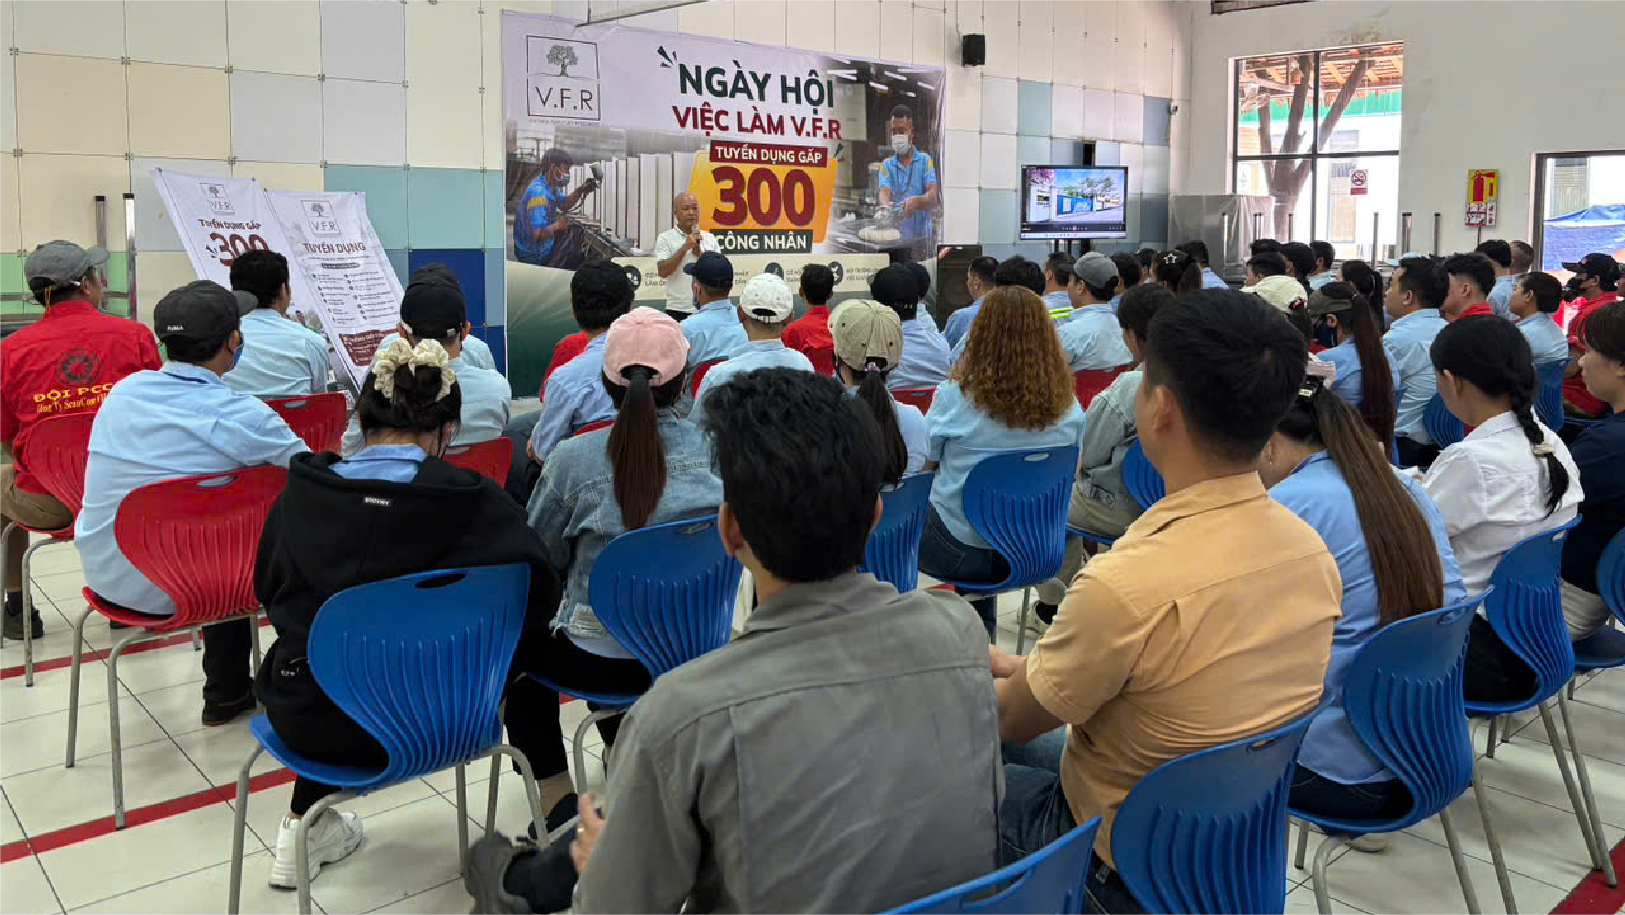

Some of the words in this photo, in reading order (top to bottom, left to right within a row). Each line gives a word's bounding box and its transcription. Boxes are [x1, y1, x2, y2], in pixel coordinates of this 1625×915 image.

[535, 87, 593, 111] V.F.R
[679, 60, 772, 102] NGÀY
[780, 69, 834, 115] HỘI
[672, 102, 729, 136] VIỆC
[737, 106, 784, 136] LÀM
[790, 116, 842, 140] V.F.R
[715, 144, 757, 160] TUYỂN
[761, 149, 795, 164] DỤNG
[798, 147, 823, 164] GẤP
[712, 166, 815, 226] 300
[716, 232, 760, 250] CÔNG
[764, 230, 807, 250] NHÂN
[78, 383, 114, 396] PCC
